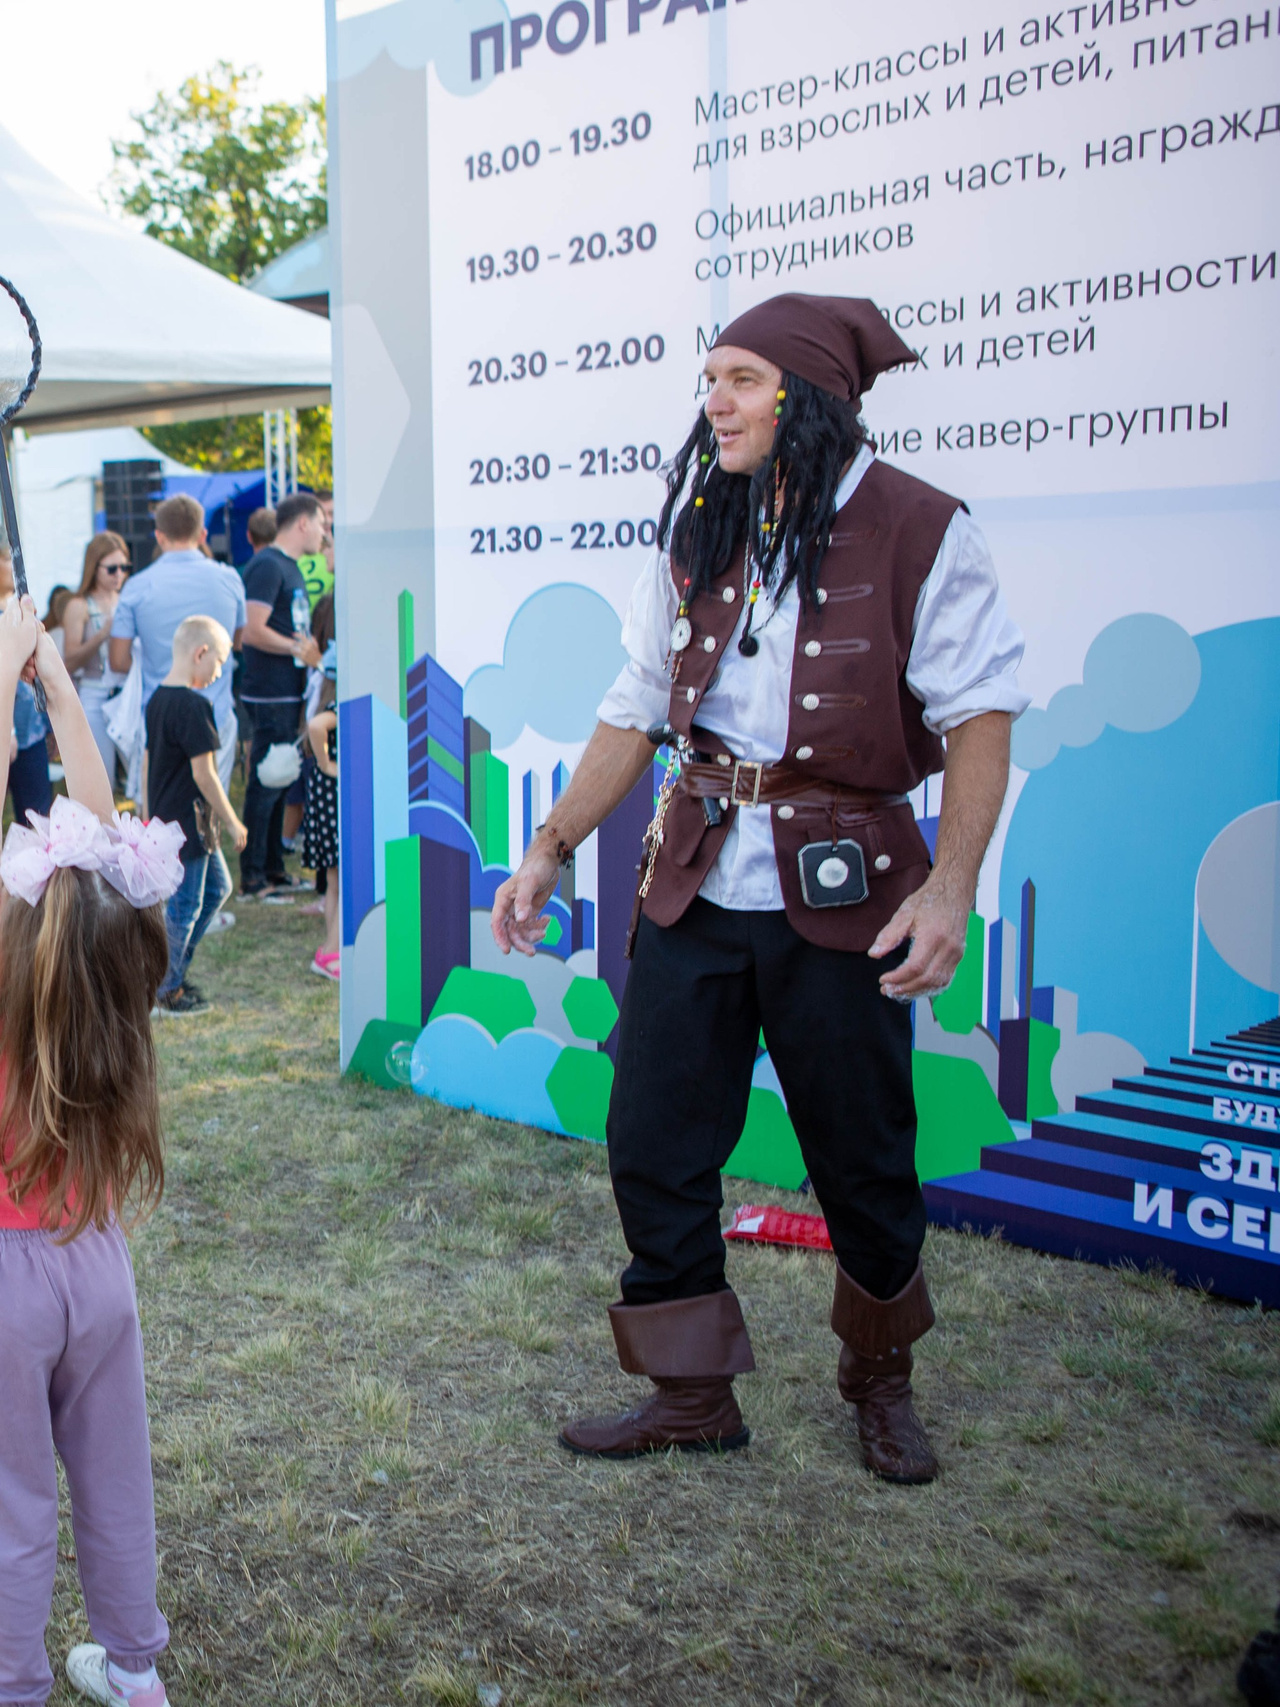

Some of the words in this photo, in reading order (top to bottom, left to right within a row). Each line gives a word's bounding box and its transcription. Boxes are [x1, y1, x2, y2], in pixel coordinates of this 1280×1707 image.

[693, 134, 747, 173] для
[761, 91, 931, 153] взрослых
[946, 82, 966, 111] и
[978, 41, 1113, 110] детей,
[1133, 7, 1280, 70] питан
[694, 36, 967, 126] Мастер-классы
[984, 27, 1004, 57] и
[465, 139, 540, 182] 18.00
[569, 112, 651, 156] 19.30
[694, 173, 929, 242] Официальная
[945, 152, 1066, 193] часть,
[466, 245, 540, 283] 19.30
[569, 222, 657, 265] 20.30
[694, 223, 914, 281] сотрудников
[981, 292, 1001, 319] и
[1016, 251, 1277, 313] активности
[468, 350, 547, 387] 20.30
[576, 334, 665, 373] 22.00
[944, 341, 963, 369] и
[976, 315, 1096, 370] детей
[936, 401, 1228, 452] кавер-группы
[469, 453, 551, 486] 20:30
[579, 443, 662, 478] 21:30
[470, 525, 543, 555] 21.30
[570, 518, 658, 551] 22.00
[1213, 1096, 1280, 1131] БУД
[1199, 1141, 1280, 1193] ЗД
[1133, 1180, 1173, 1230] И
